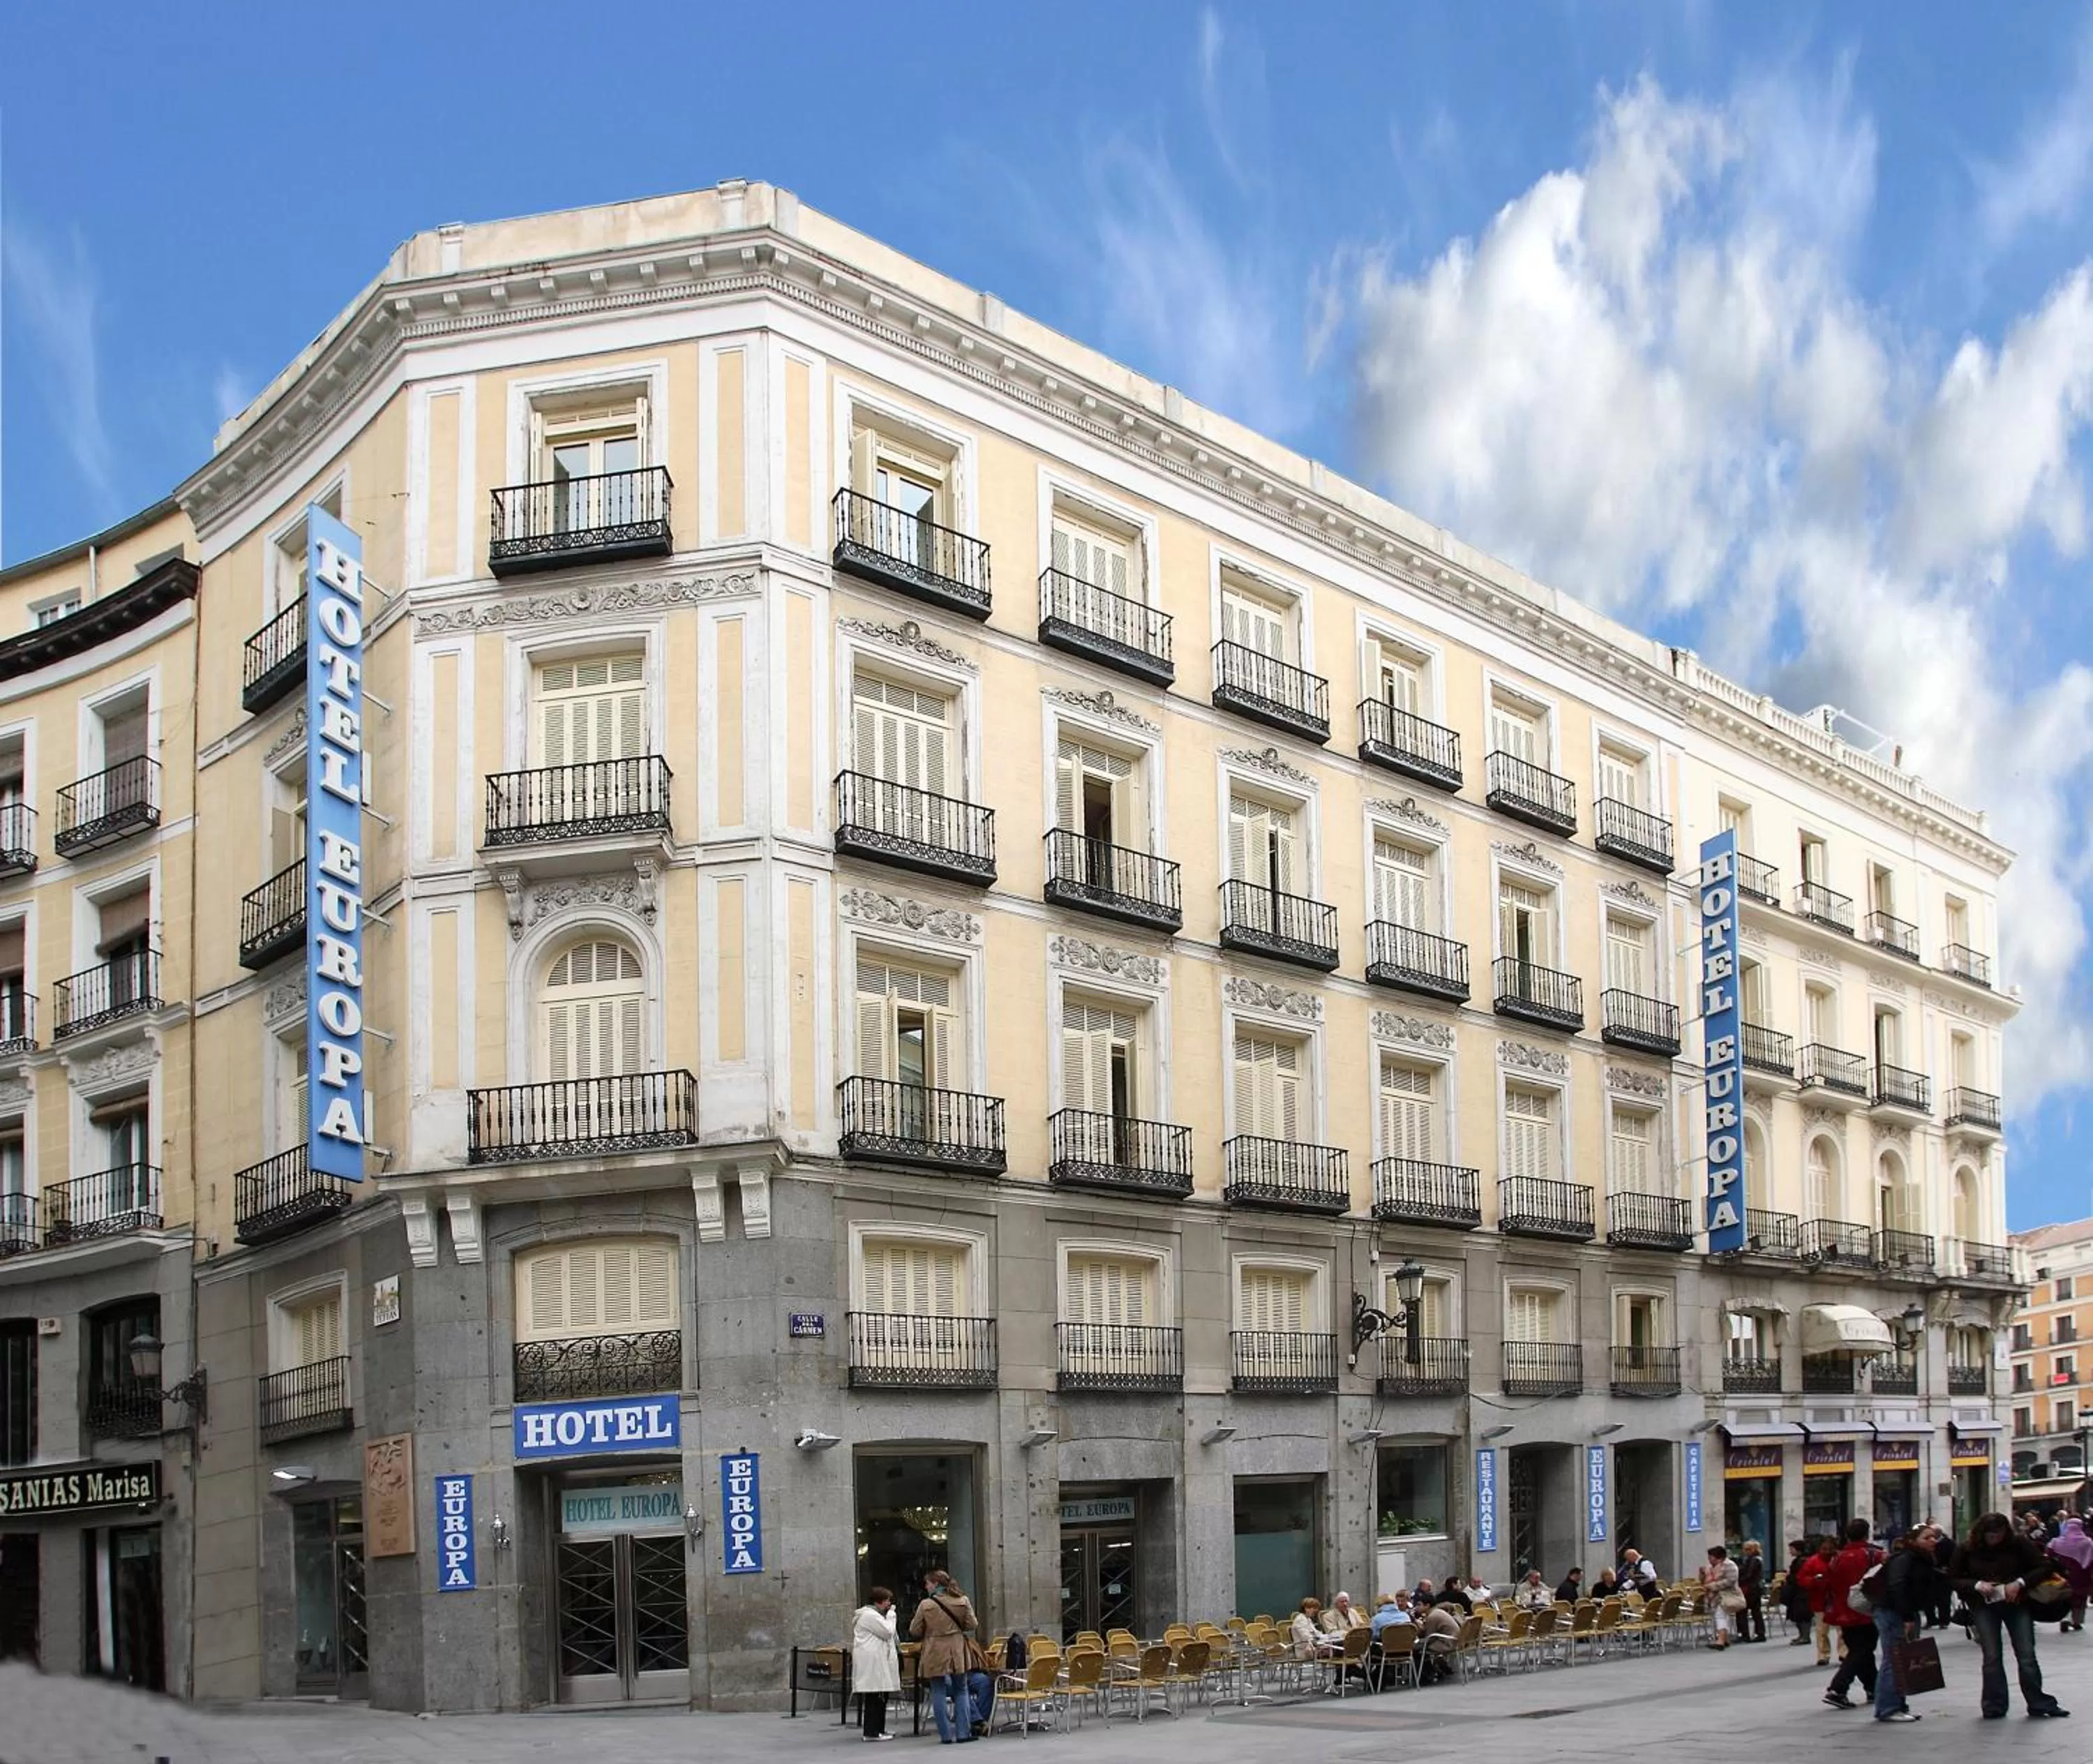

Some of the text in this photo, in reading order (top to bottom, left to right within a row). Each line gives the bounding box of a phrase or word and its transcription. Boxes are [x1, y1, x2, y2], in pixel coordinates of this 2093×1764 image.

[315, 537, 363, 1145] HOTEL EUROPA
[1700, 851, 1739, 1230] HOTEL EUROPA
[523, 1405, 672, 1448] HOTEL
[87, 1470, 151, 1502] Marisa
[566, 1491, 682, 1523] HOTEL EUROPA
[728, 1459, 756, 1568] EUROPA
[1086, 1502, 1130, 1516] EUROPA
[1480, 1452, 1493, 1547] RESTAURANTE
[1590, 1449, 1604, 1537] EUROPA
[1689, 1448, 1699, 1526] CAFETERIA
[442, 1480, 470, 1585] EUROPA
